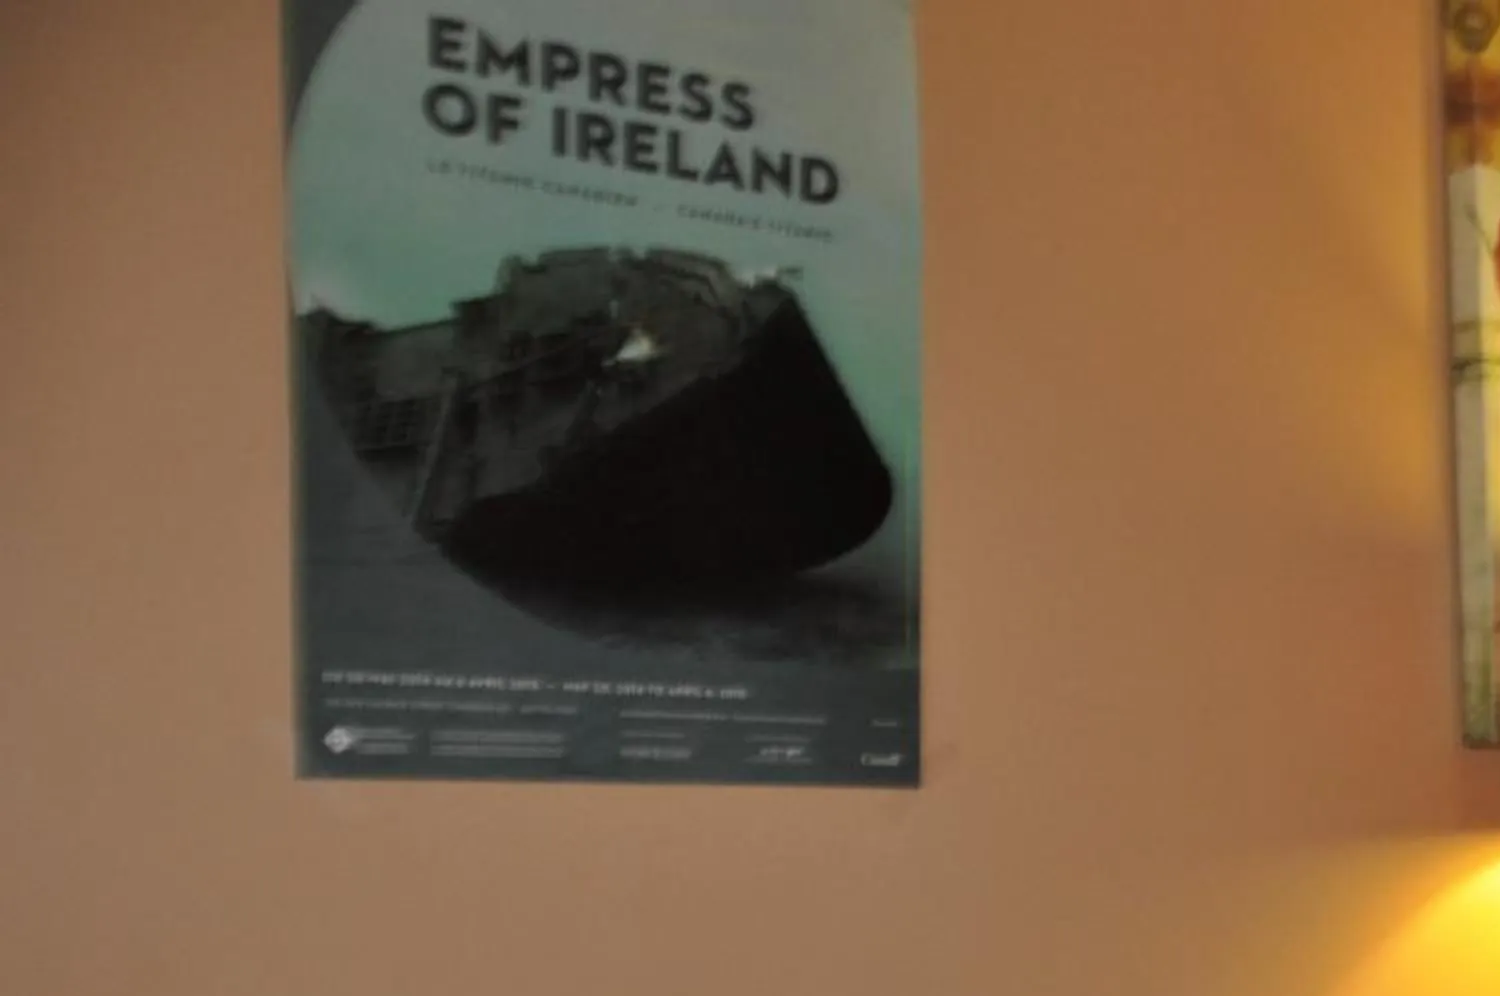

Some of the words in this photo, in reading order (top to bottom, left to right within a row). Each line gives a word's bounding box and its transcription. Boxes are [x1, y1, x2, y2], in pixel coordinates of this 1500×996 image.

[427, 15, 757, 130] EMPRESS
[421, 83, 525, 147] OF
[551, 107, 840, 206] IRELAND
